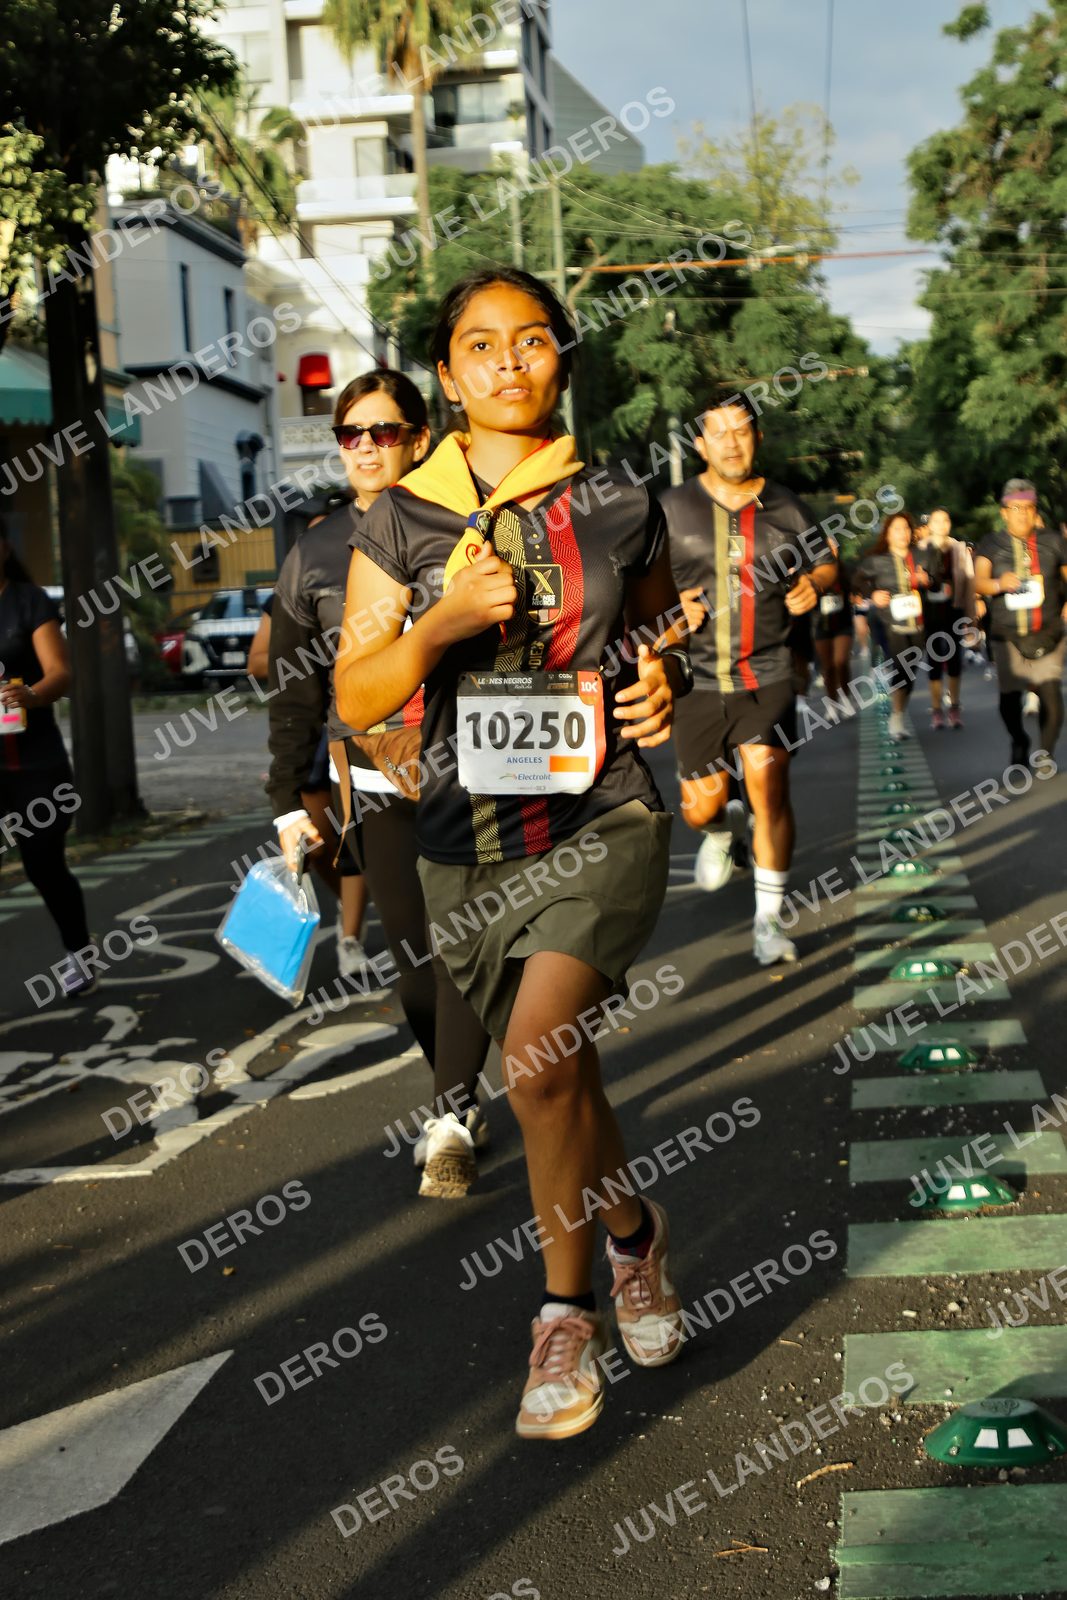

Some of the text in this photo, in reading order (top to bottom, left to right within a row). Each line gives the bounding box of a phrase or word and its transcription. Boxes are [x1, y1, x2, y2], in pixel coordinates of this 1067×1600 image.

[477, 677, 503, 685] LENES
[465, 711, 586, 750] 10250
[506, 756, 543, 764] ANGELES
